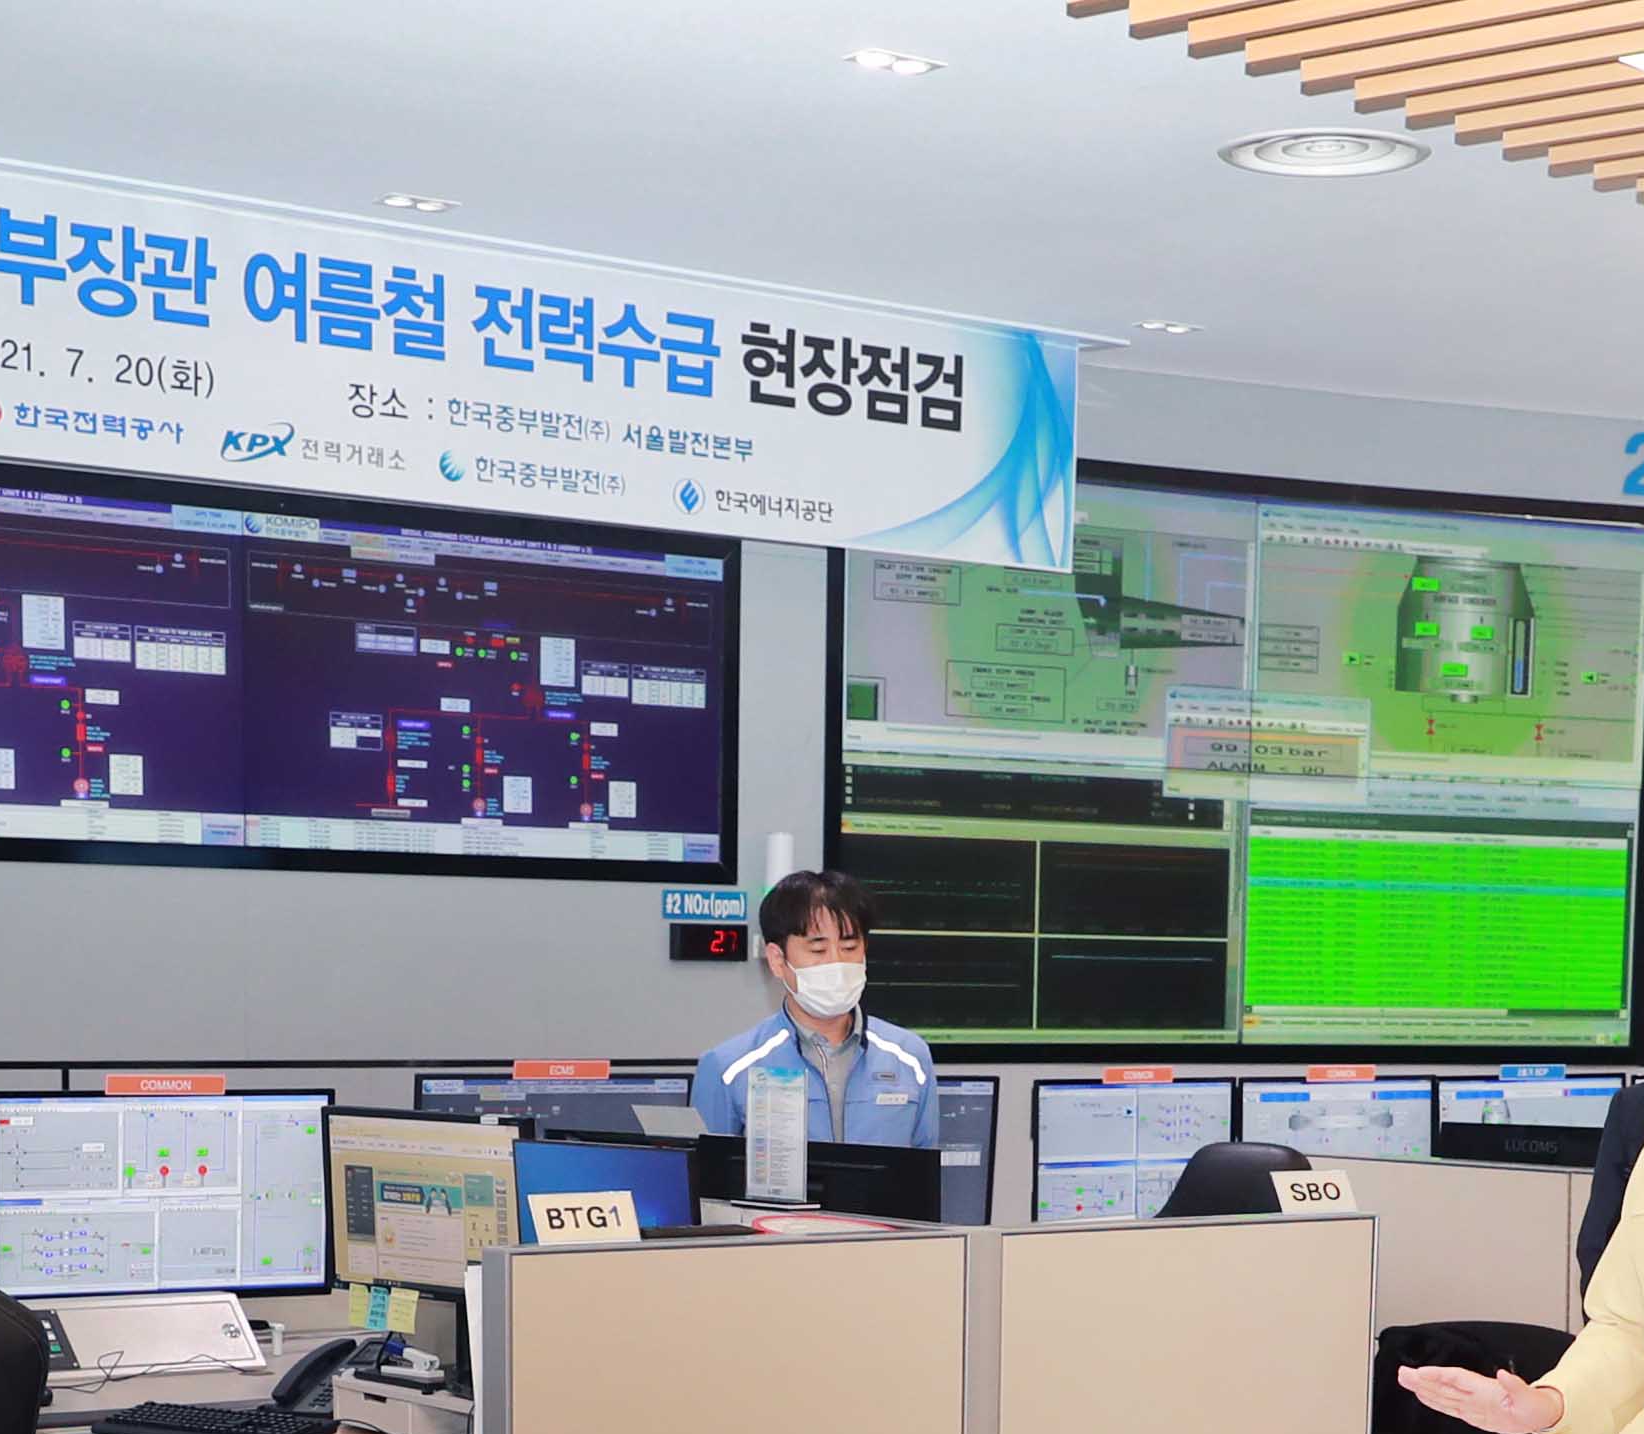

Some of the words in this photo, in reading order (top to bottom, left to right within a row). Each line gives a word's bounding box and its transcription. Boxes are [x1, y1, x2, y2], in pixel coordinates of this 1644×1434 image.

[243, 250, 449, 363] 여름철
[472, 284, 722, 399] 전력수급
[741, 321, 965, 433] 현장점검
[65, 347, 94, 383] 7.
[114, 353, 215, 399] 20(화)
[13, 401, 184, 446] 한국전력공사
[347, 382, 410, 422] 장소
[426, 396, 434, 422] :
[447, 397, 612, 445] 한국중부발전(주)
[622, 422, 755, 461] 서울발전본부
[221, 424, 294, 460] KPX
[300, 437, 407, 473] 전력거래소
[474, 455, 627, 497] 한국중부발전(주)
[265, 515, 318, 530] KOMIPO
[714, 489, 835, 523] 한국에너지공단
[666, 893, 681, 914] #2
[684, 892, 745, 918] NOx(ppm)
[139, 1078, 193, 1092] COMMON
[549, 1064, 575, 1075] ECMS
[1290, 1181, 1341, 1202] SBO
[547, 1204, 623, 1230] BTG1
